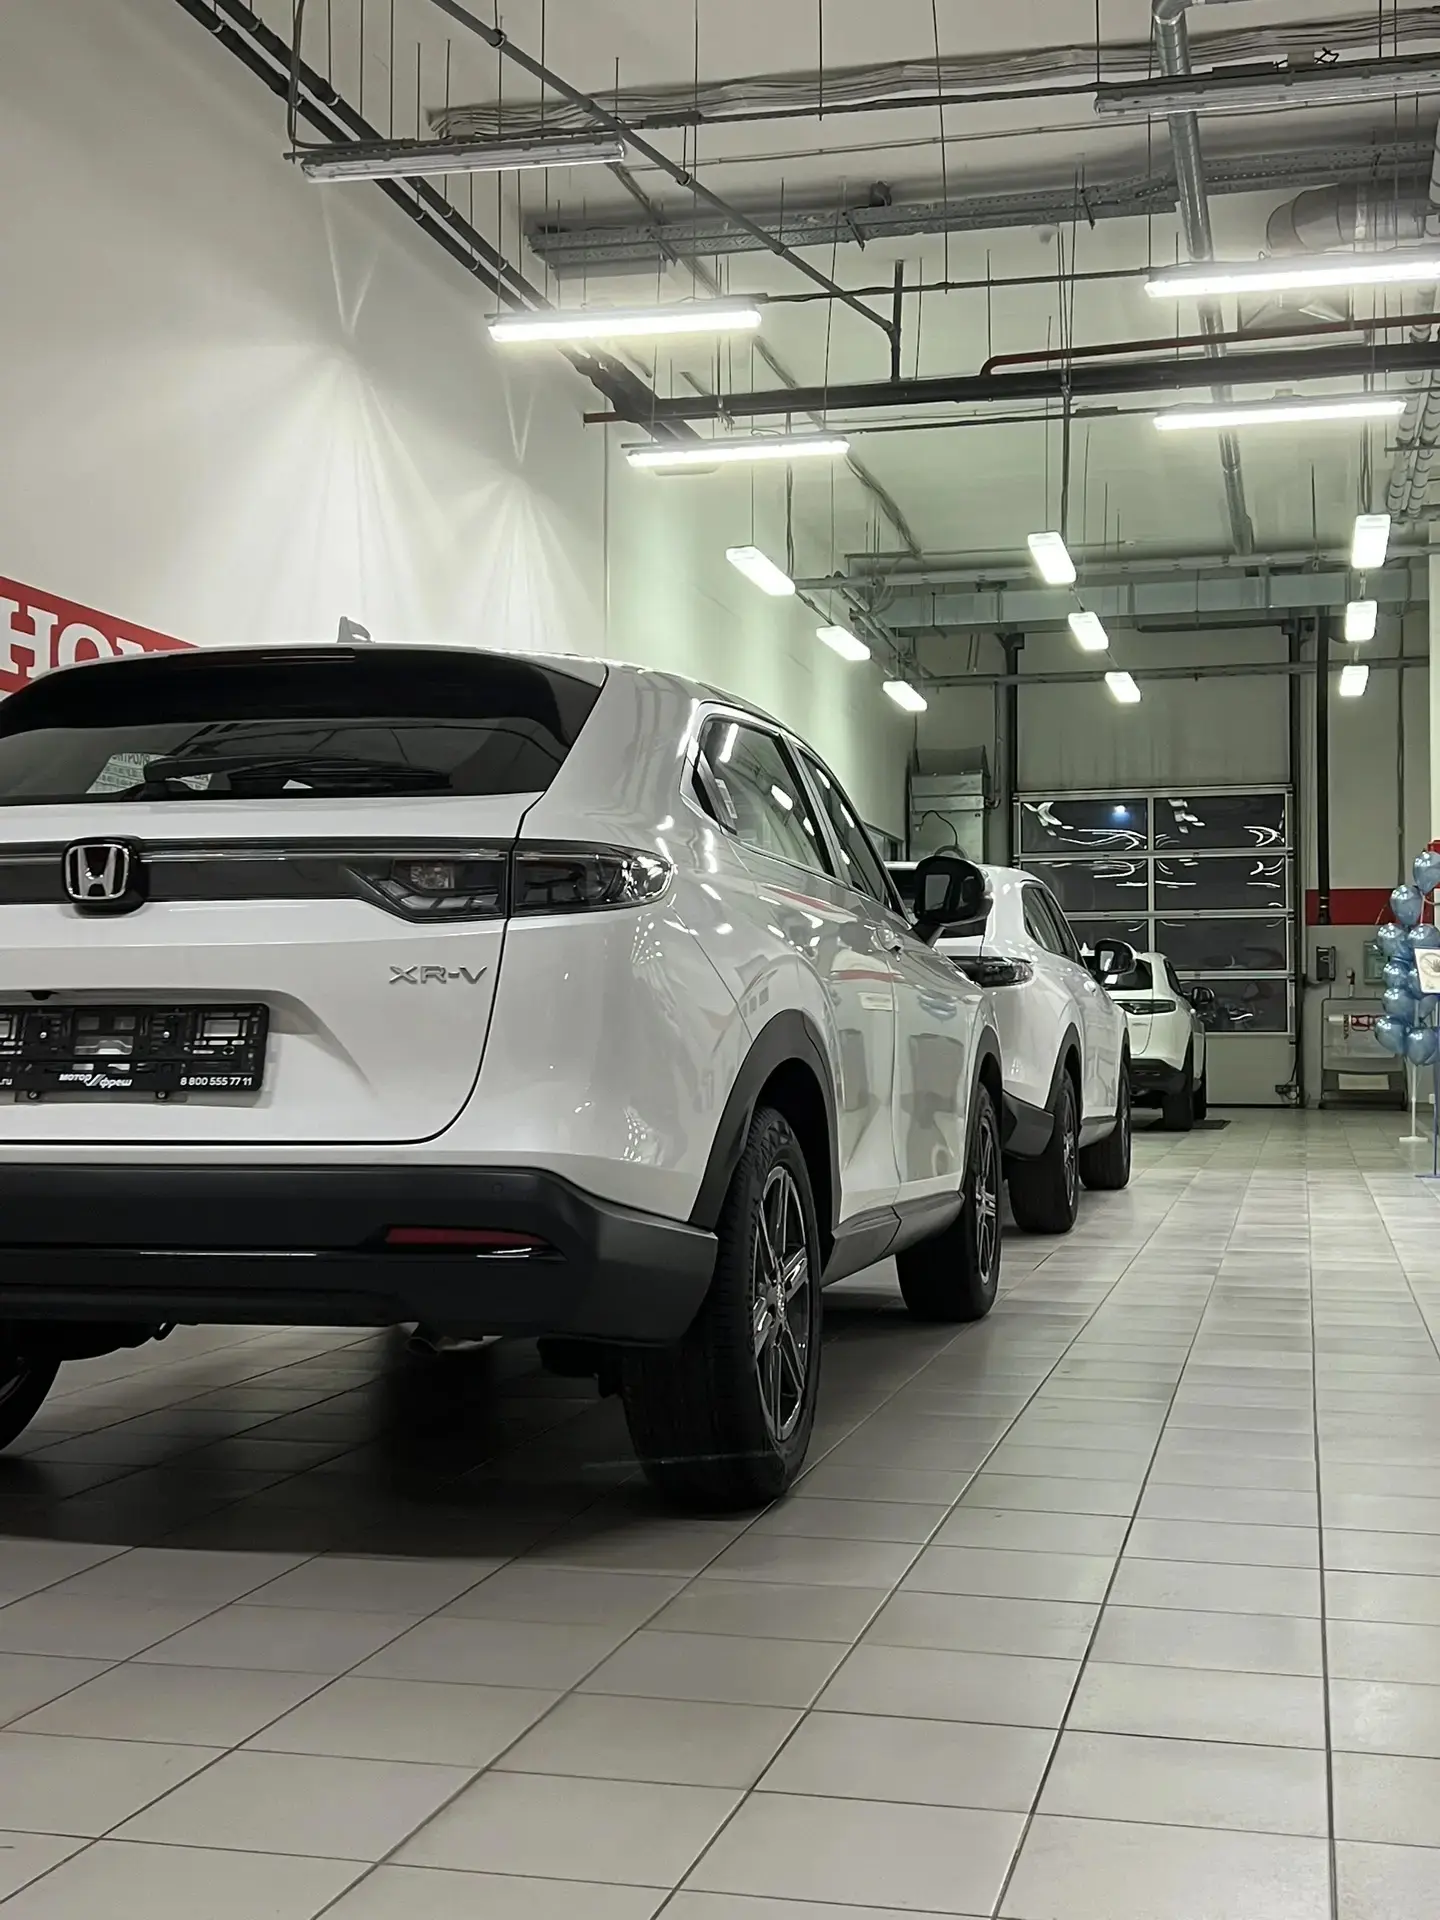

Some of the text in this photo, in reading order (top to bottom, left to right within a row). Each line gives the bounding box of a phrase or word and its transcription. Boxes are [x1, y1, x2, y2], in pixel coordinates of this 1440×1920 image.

[0, 596, 166, 678] HO
[388, 965, 488, 985] XR-V
[180, 1076, 253, 1086] 8 800 555 77 11
